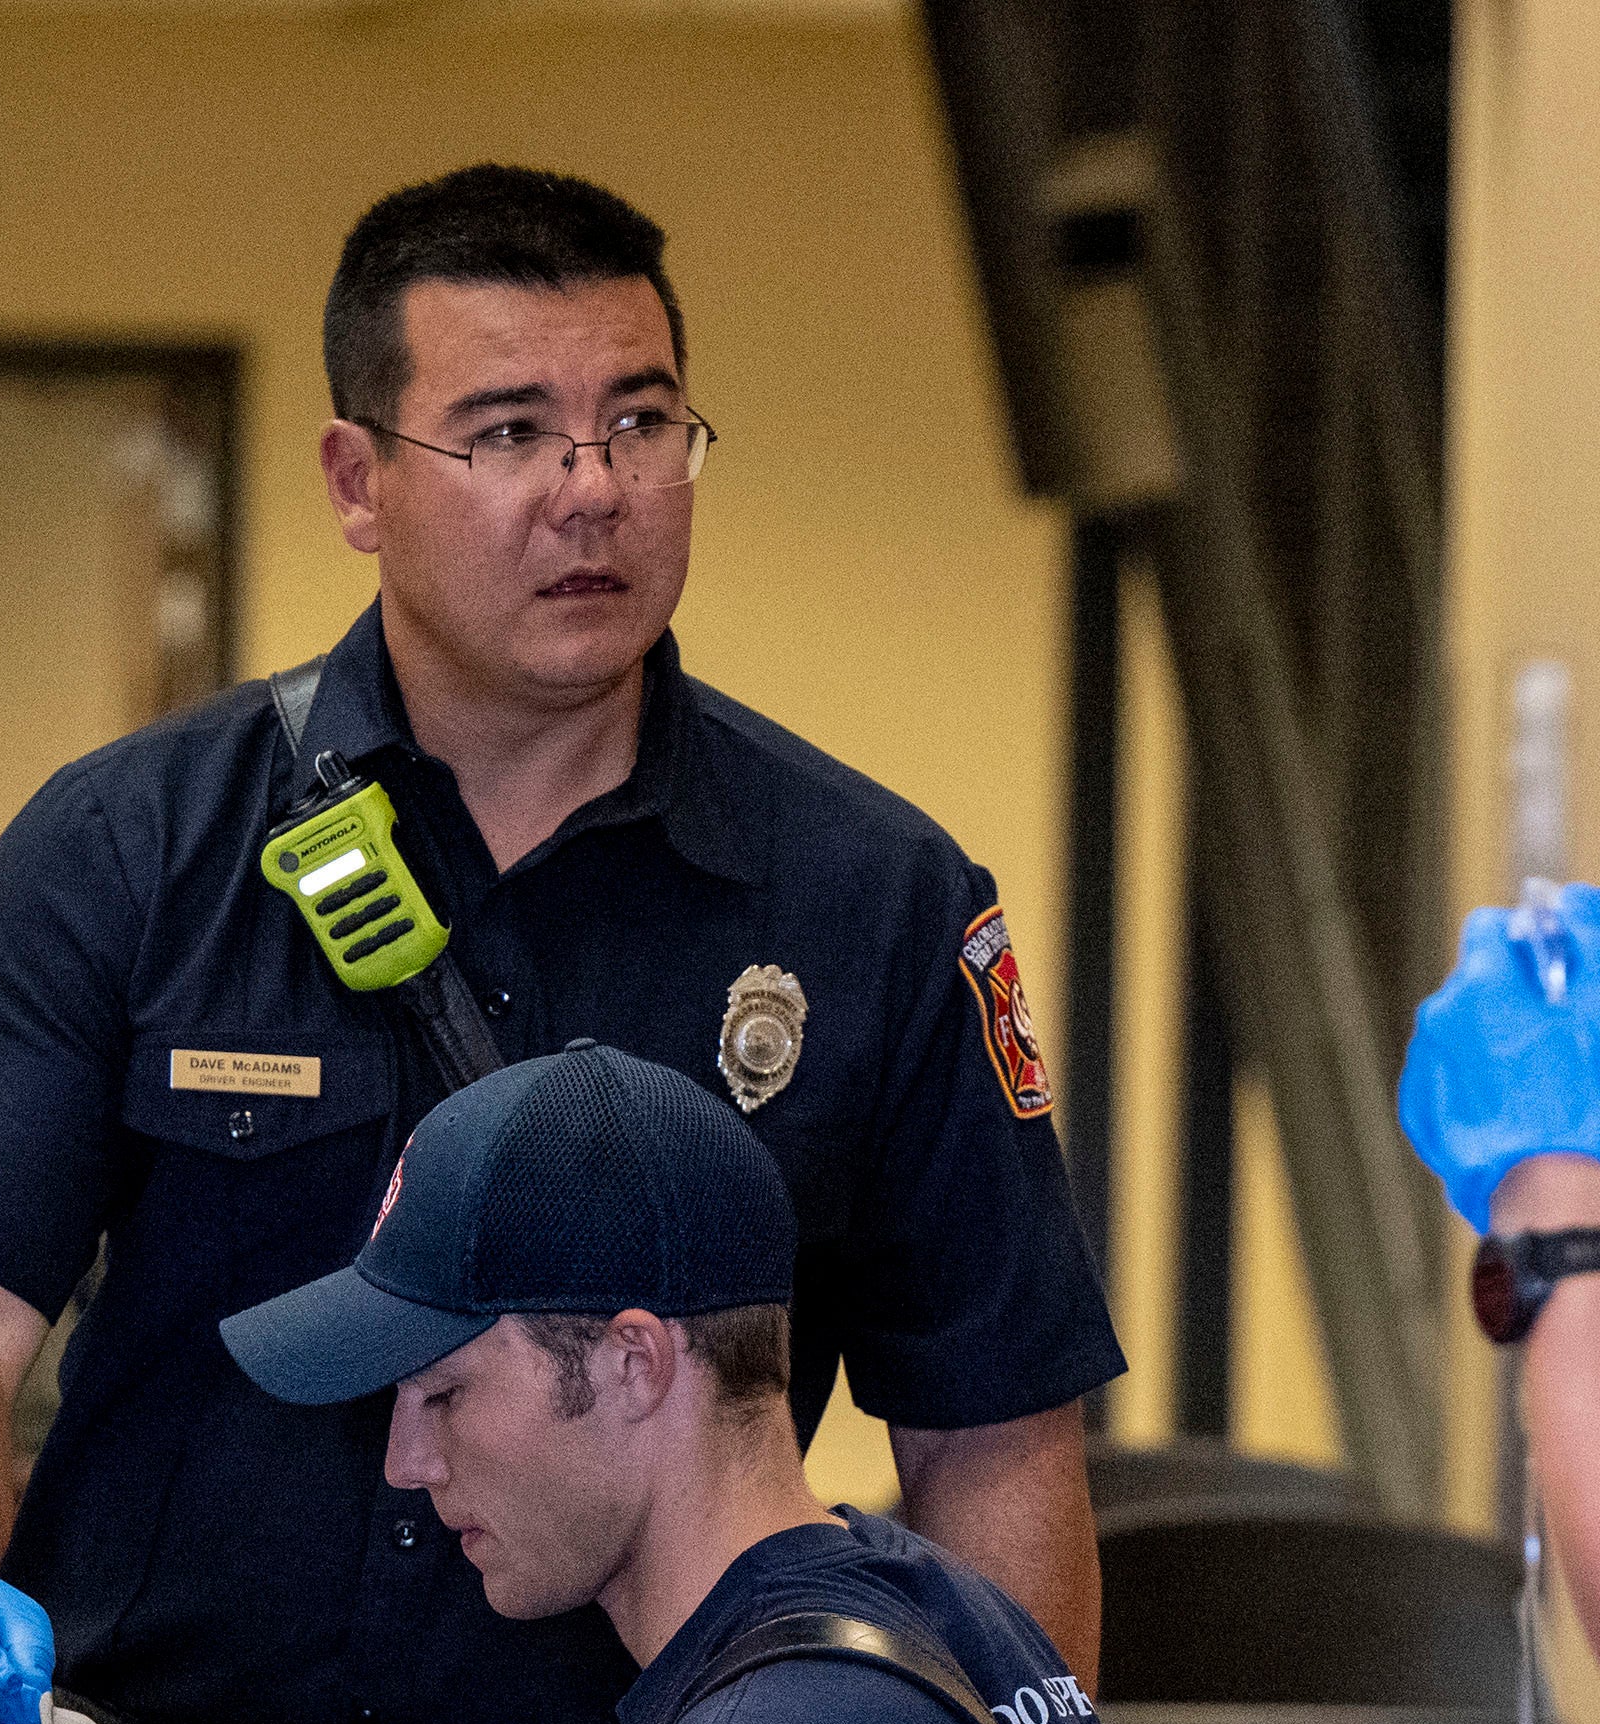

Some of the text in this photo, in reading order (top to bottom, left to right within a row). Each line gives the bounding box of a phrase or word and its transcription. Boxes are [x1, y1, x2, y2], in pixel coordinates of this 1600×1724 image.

[301, 823, 357, 858] MOTOROLA
[190, 1057, 302, 1075] DAVE McADAMS
[199, 1075, 292, 1089] DRIVER ENGINEER
